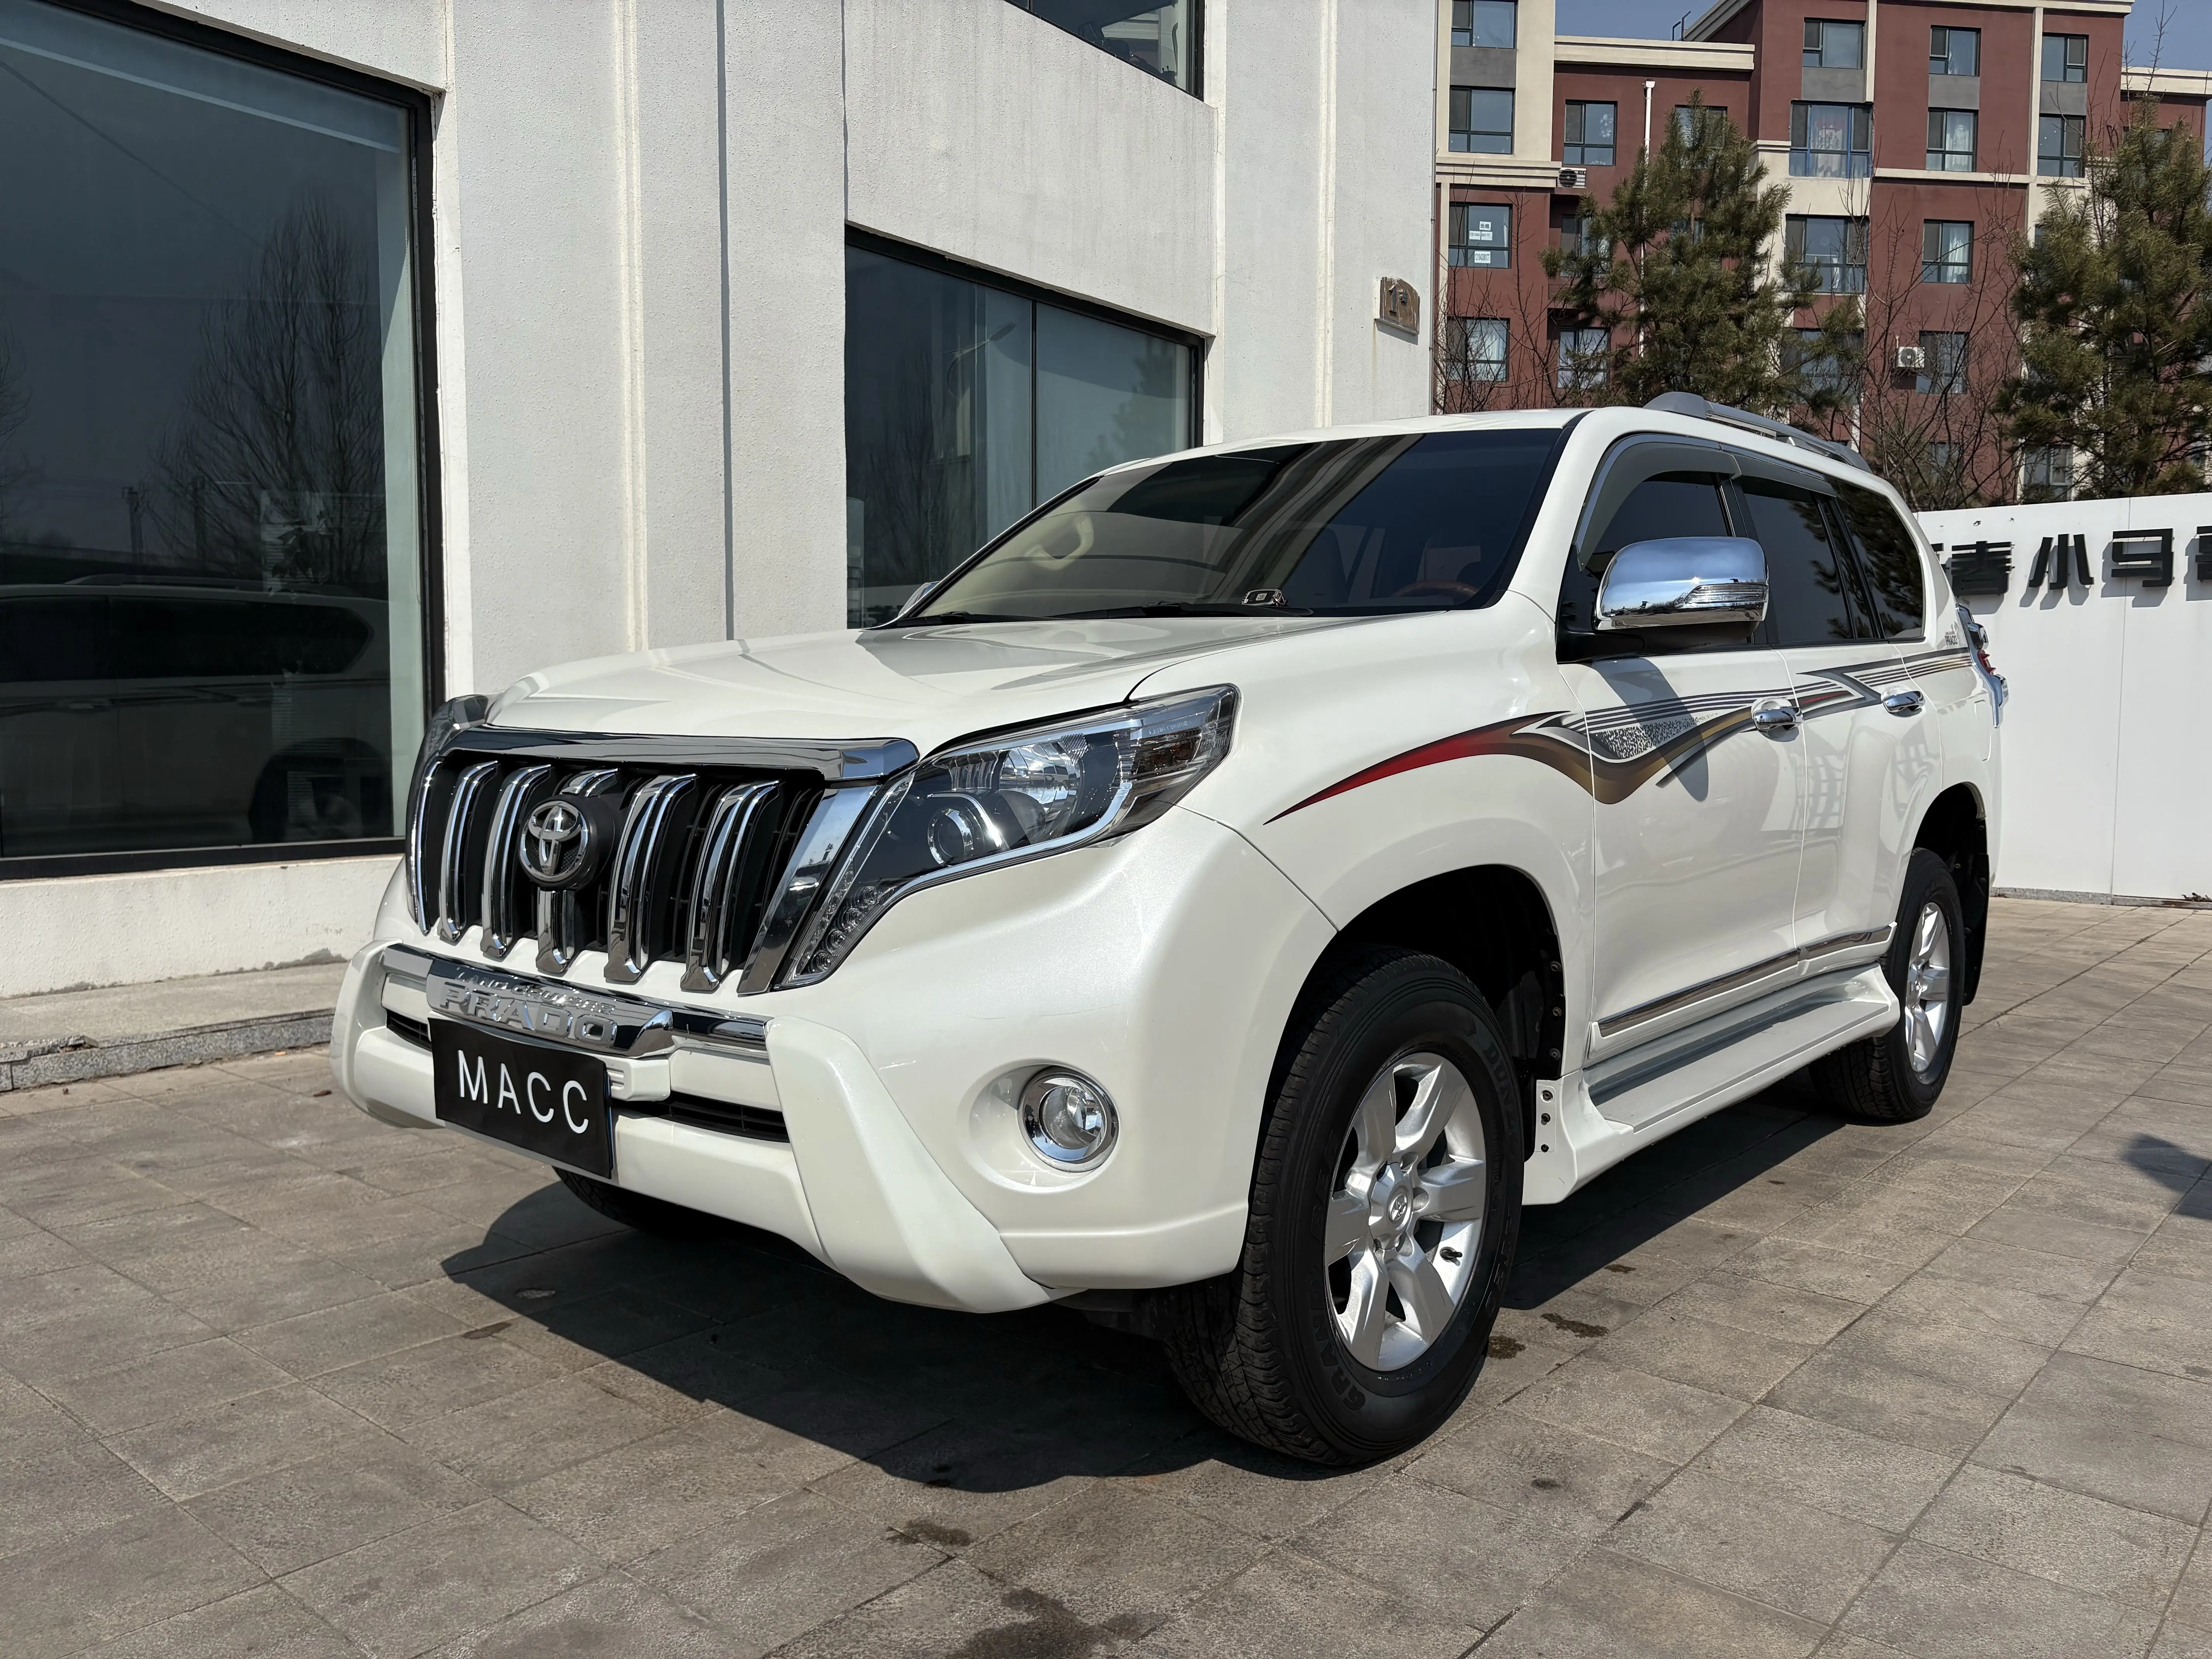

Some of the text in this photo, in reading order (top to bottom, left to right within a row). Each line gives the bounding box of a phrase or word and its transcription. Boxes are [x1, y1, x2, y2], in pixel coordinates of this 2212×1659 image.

[1930, 526, 2212, 596] 春小马
[1945, 635, 1958, 646] PRADO
[440, 981, 618, 1048] PRADO
[455, 972, 617, 1016] LAND CRUISER
[457, 1049, 589, 1134] MACC
